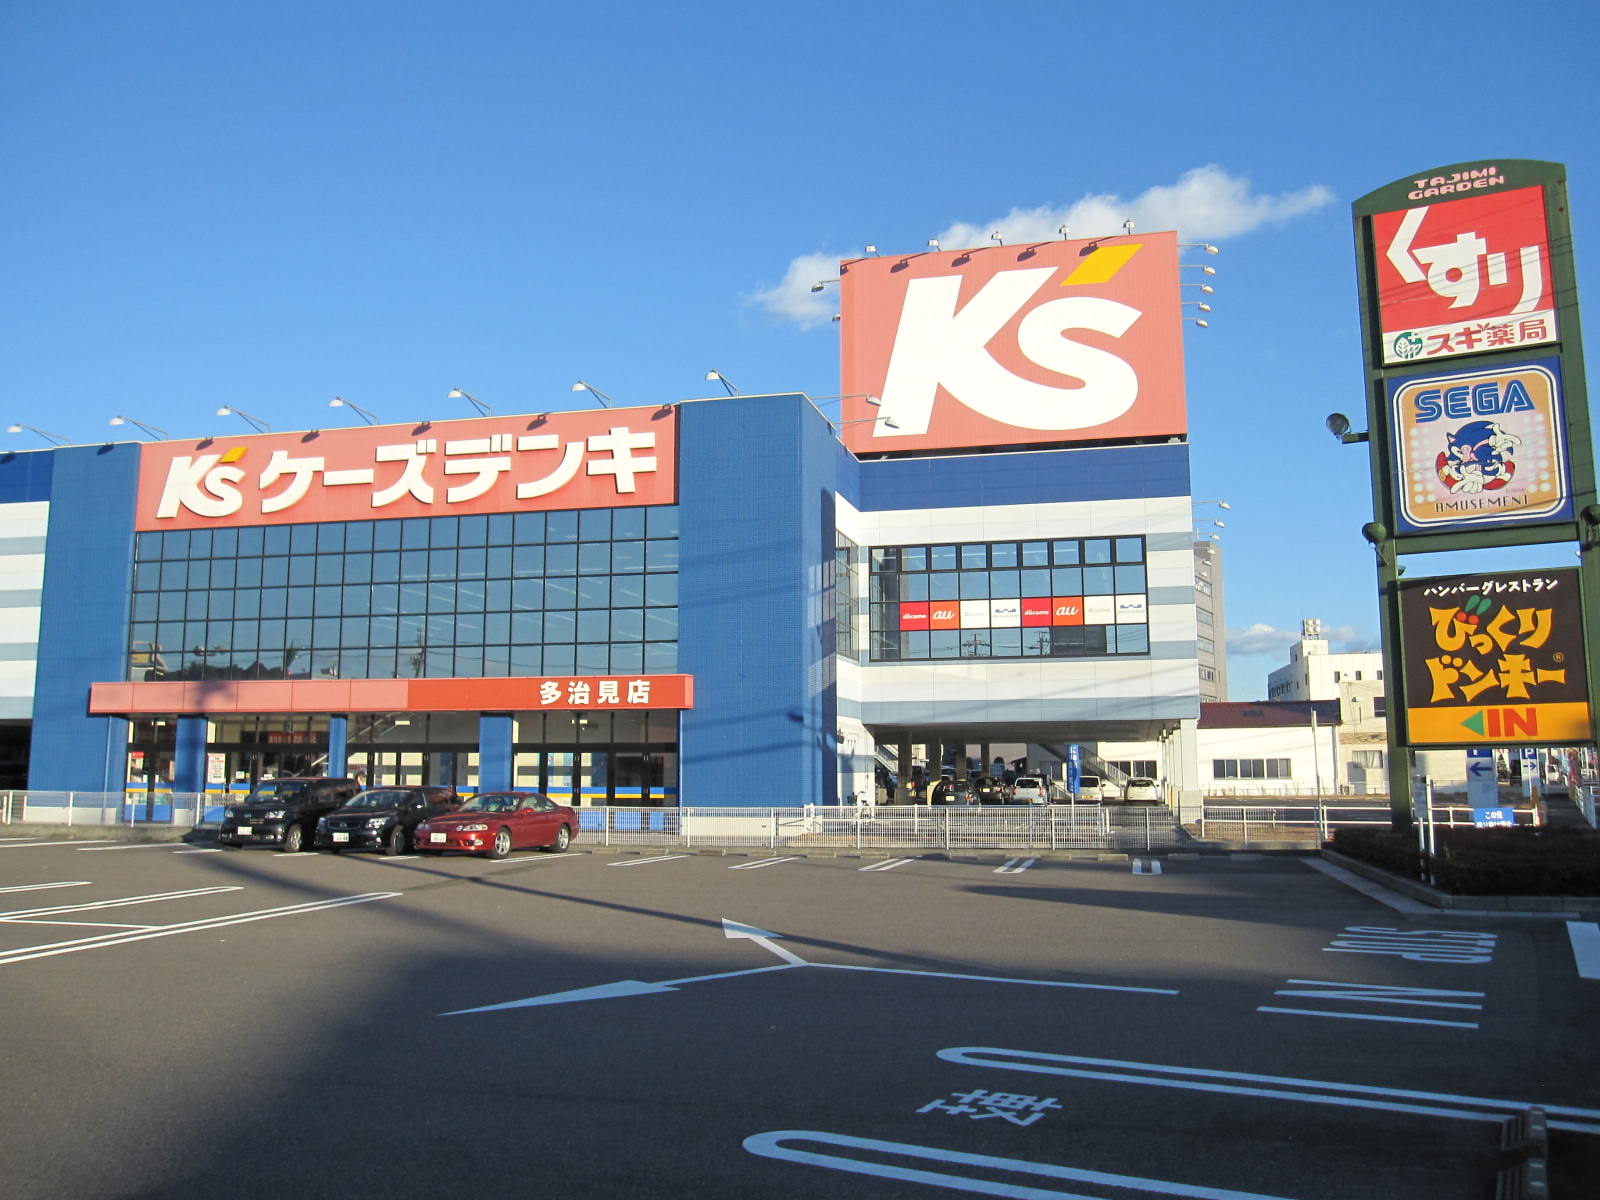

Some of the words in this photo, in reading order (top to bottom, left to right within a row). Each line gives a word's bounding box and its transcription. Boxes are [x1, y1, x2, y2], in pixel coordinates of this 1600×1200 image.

[1407, 175, 1505, 201] GARDEN
[1413, 166, 1497, 189] TAJIMI
[1385, 204, 1545, 316] くすり
[1425, 318, 1548, 357] スギ薬局
[1414, 378, 1536, 424] SEGA
[258, 426, 657, 514] ケーズデンキ
[1435, 494, 1529, 513] AMUSEMENT
[1423, 578, 1559, 597] ハンバーグレストラン
[933, 610, 955, 620] au
[1056, 606, 1079, 616] au
[1428, 604, 1553, 655] びっくり
[539, 680, 650, 705] 多治見店
[1425, 653, 1566, 703] ドンキー
[1487, 707, 1538, 738] IN
[915, 1089, 1063, 1126] 軽
